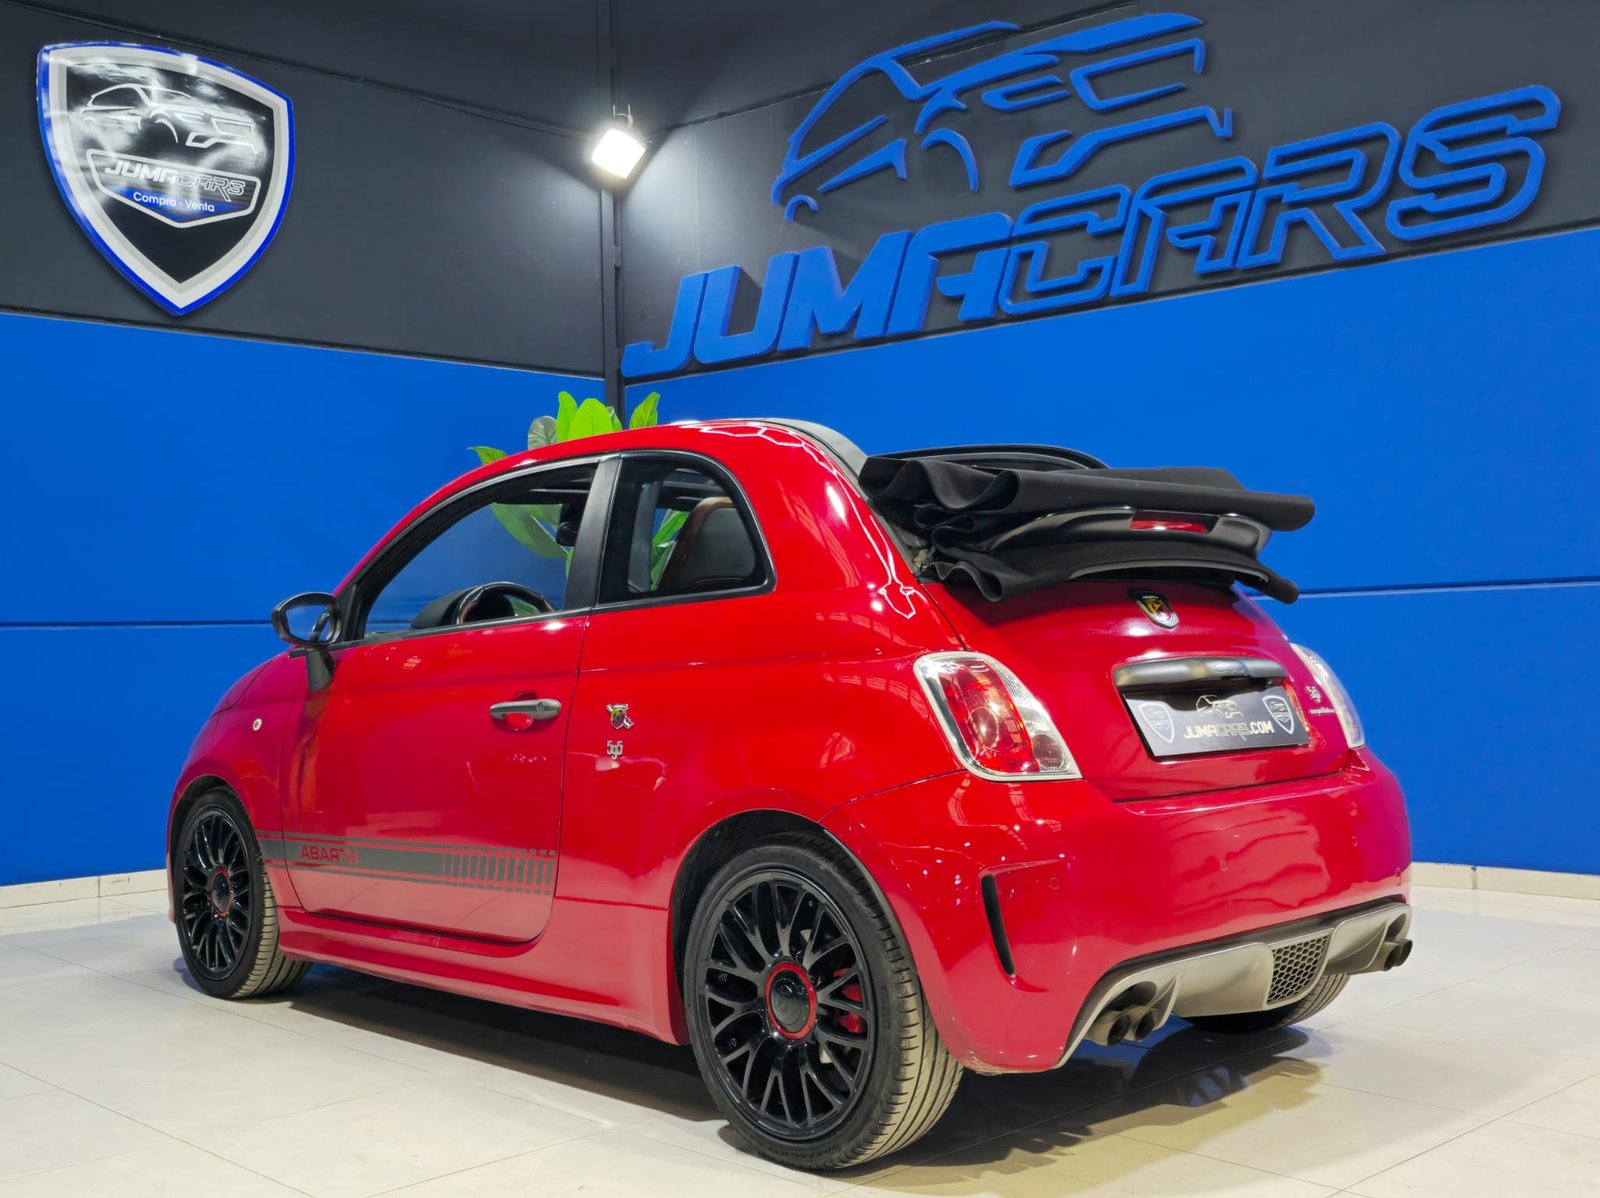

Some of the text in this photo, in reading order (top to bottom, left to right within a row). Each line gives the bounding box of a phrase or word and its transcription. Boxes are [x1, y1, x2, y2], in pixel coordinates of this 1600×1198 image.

[104, 160, 246, 202] JUMACARS
[133, 191, 177, 207] Compra
[185, 199, 215, 213] Venta
[621, 84, 1561, 378] JUMACARS
[301, 845, 359, 865] ABARTH
